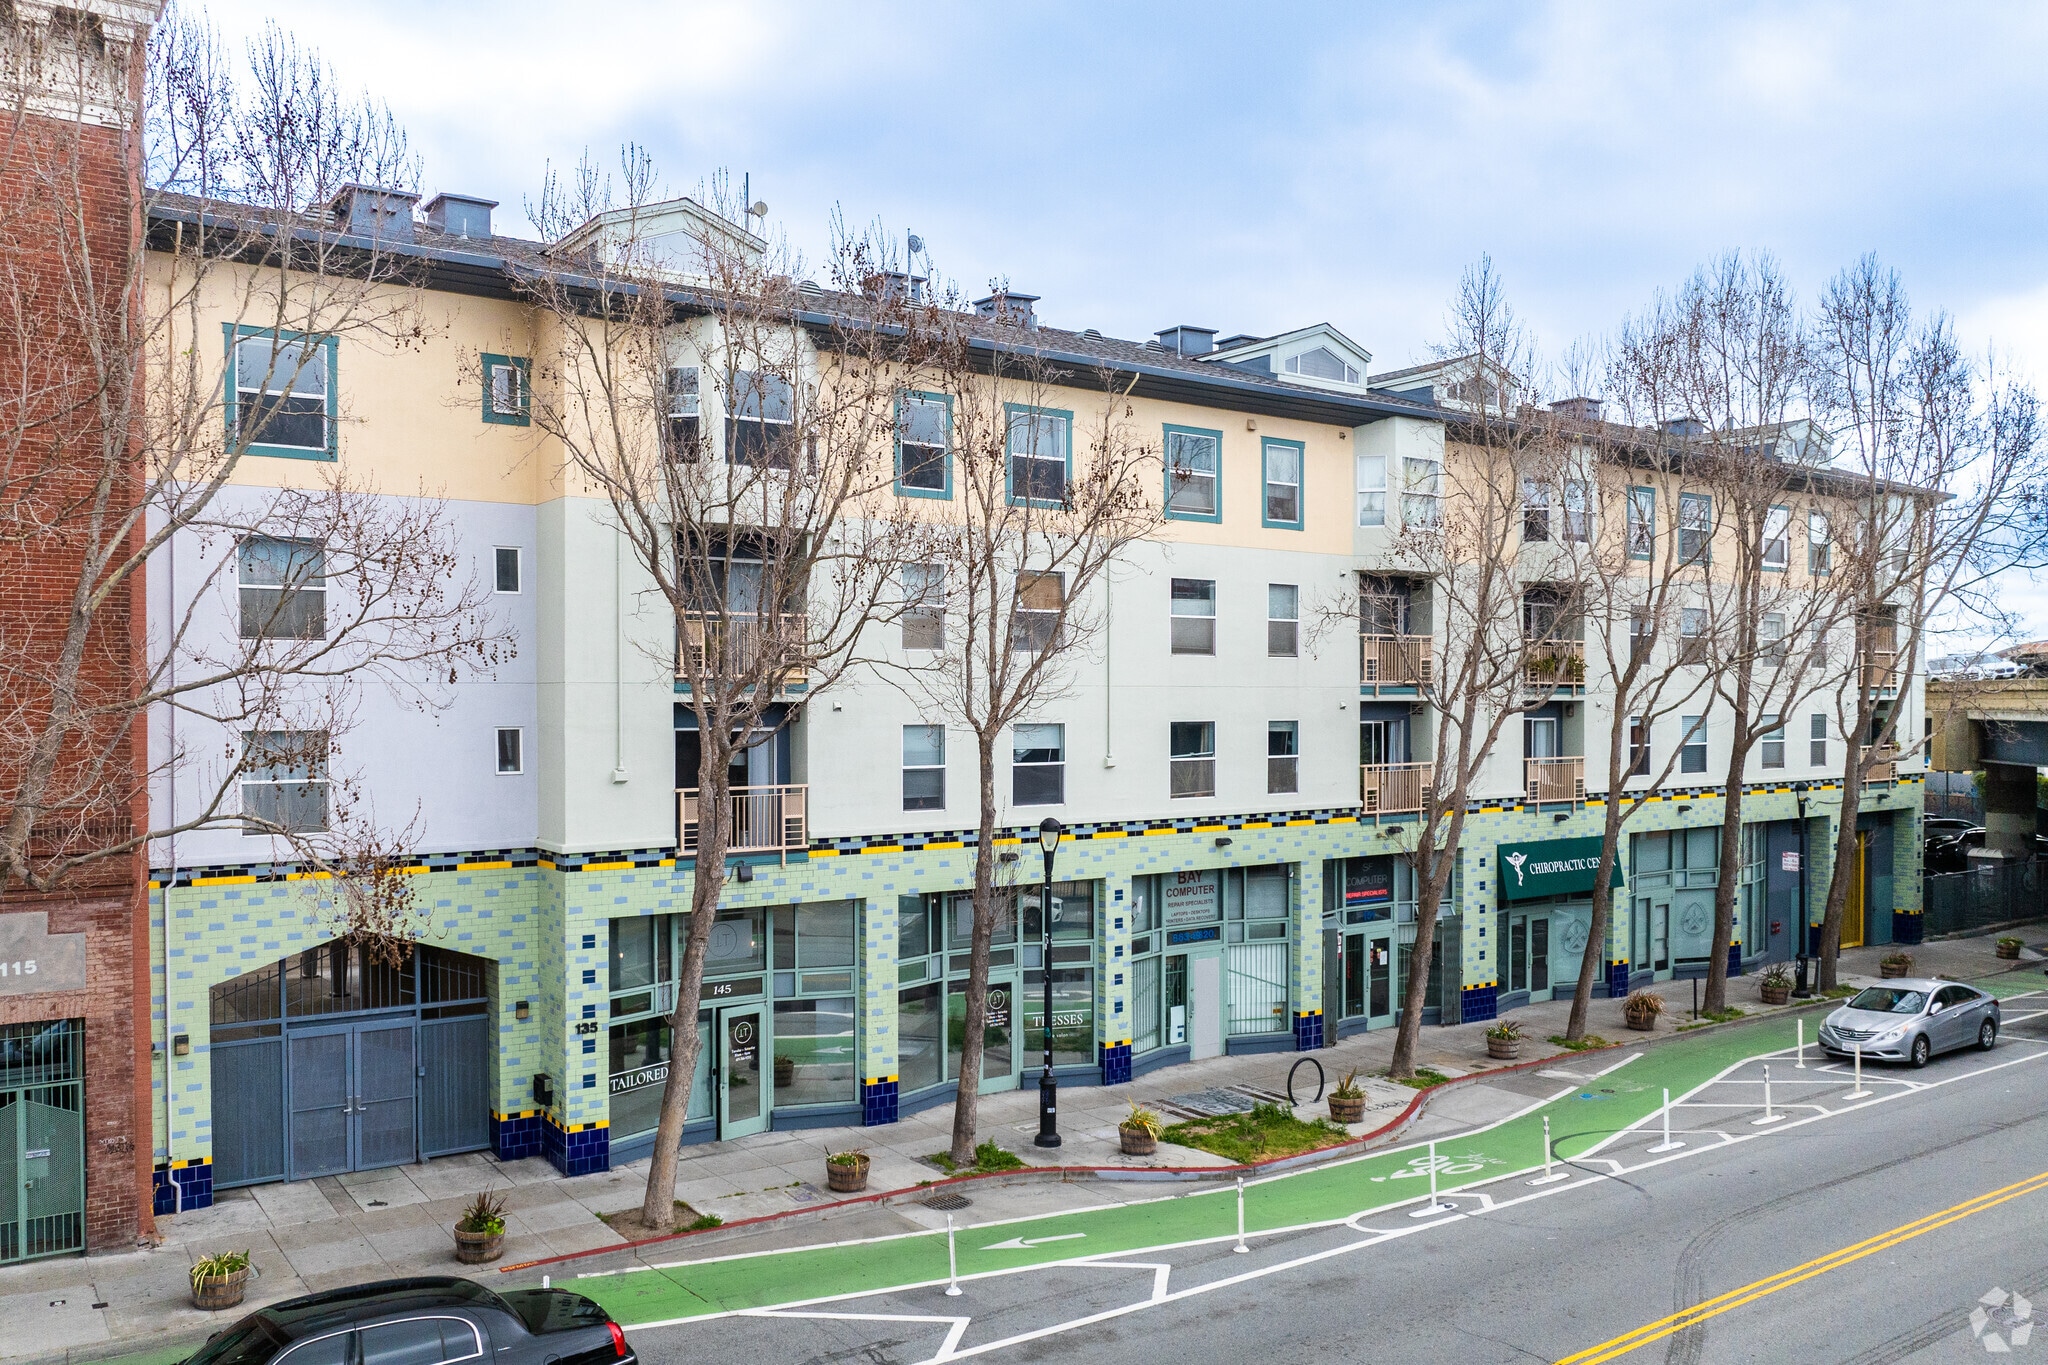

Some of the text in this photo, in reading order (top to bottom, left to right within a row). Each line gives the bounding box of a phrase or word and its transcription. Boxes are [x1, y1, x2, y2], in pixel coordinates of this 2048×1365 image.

[1529, 859, 1585, 875] CHIROPRACTIC
[1178, 870, 1203, 884] BAY
[1346, 874, 1388, 887] COMPUTER
[1166, 885, 1215, 897] COMPUTER
[0, 960, 37, 977] 115
[713, 984, 732, 995] 145
[1033, 1013, 1084, 1027] TESSES
[575, 1022, 598, 1034] 135
[610, 1067, 669, 1091] TAILORED
